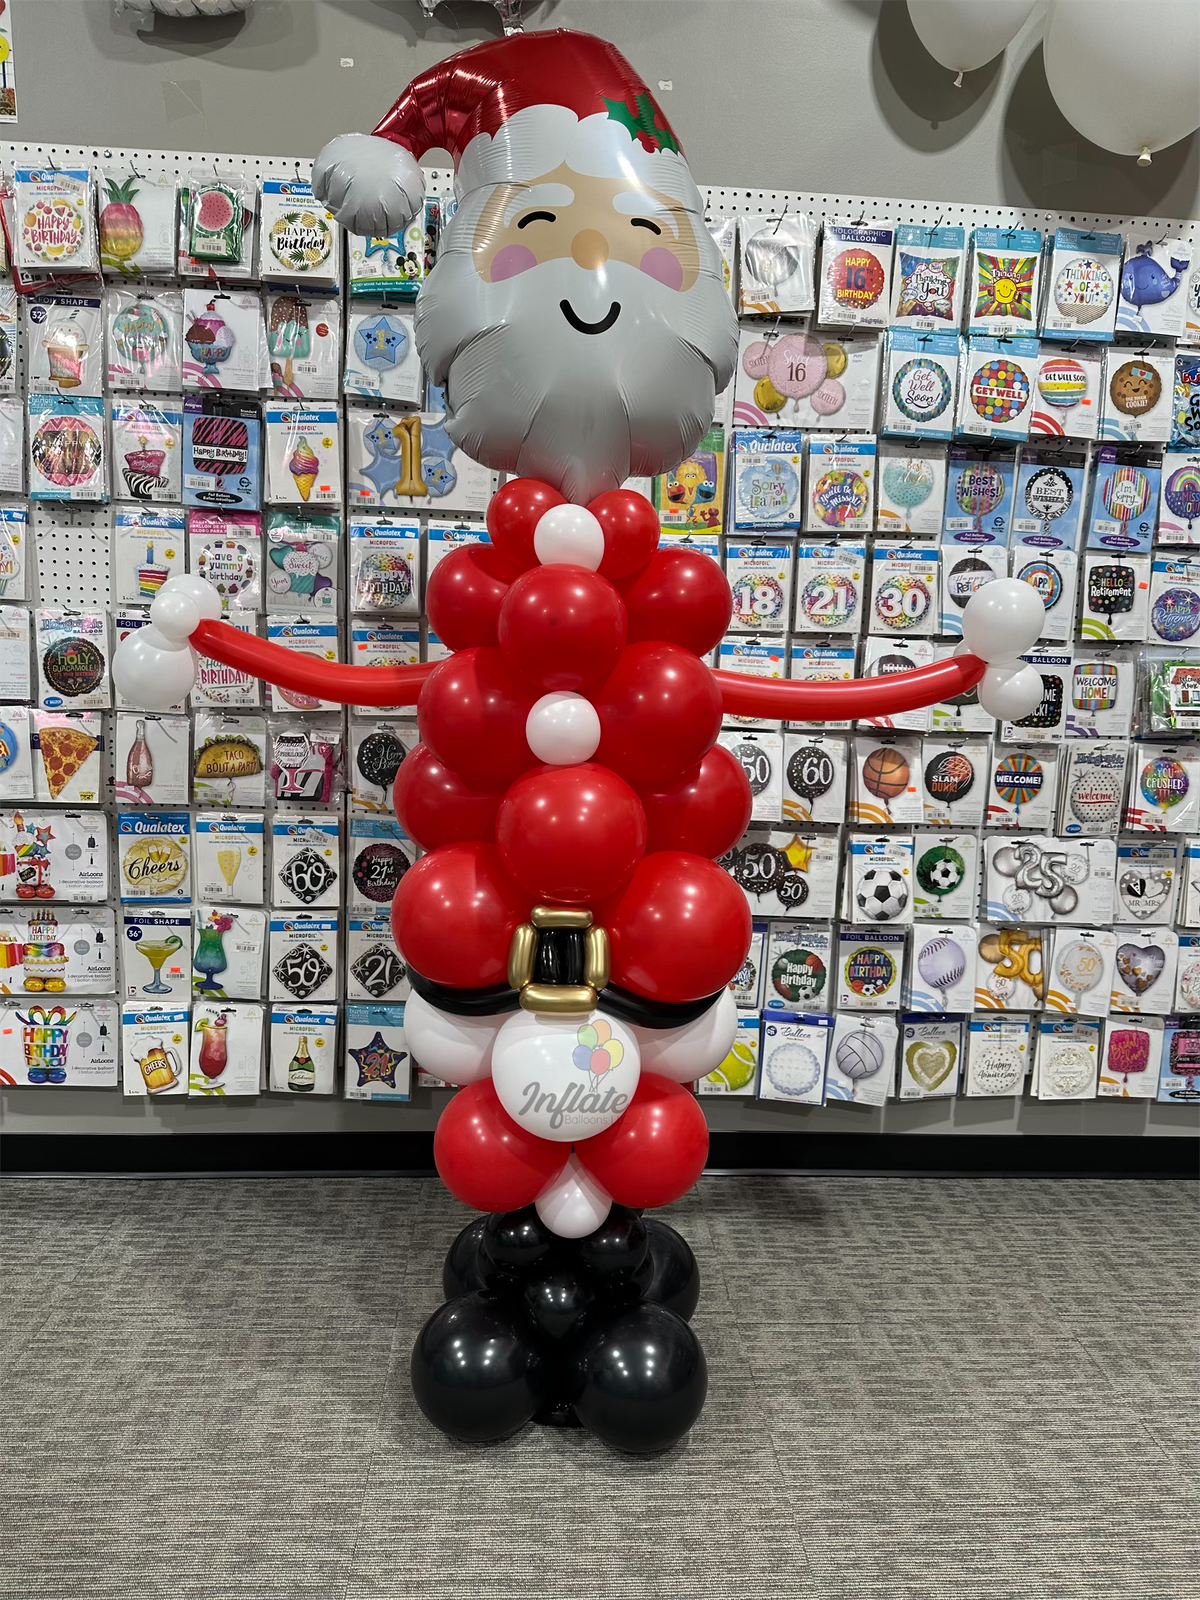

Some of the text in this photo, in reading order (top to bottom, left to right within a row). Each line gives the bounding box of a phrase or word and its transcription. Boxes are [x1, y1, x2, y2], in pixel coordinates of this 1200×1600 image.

[37, 215, 71, 230] HAPPY
[31, 229, 78, 245] BIRTHDAY
[284, 228, 318, 236] HAPPY
[832, 228, 886, 237] HOLOGRAPHIC
[841, 234, 877, 242] BALLOON
[1058, 231, 1077, 239] burton
[277, 238, 325, 250] Birthday
[846, 257, 871, 267] HAPPY
[915, 274, 947, 287] Thinking
[991, 269, 1022, 281] Thinking
[1066, 268, 1107, 281] THINKING
[1080, 282, 1090, 292] OF
[837, 289, 874, 300] BIRTHDAY
[1074, 293, 1095, 304] YOU!
[60, 298, 88, 306] SHAPE
[749, 355, 770, 368] SIXTEEN
[787, 363, 806, 382] 16
[913, 370, 931, 381] Get
[908, 380, 935, 392] Well
[817, 390, 838, 406] SIXTEEN
[975, 386, 1023, 399] GET WELL
[1126, 400, 1148, 408] COOKIE!
[292, 413, 320, 421] Qualatex
[750, 440, 798, 452] Qualatex
[752, 479, 785, 496] Sorry
[1036, 487, 1064, 495] BEST
[210, 562, 243, 572] yummy
[289, 558, 312, 570] Sweet
[210, 572, 243, 582] birthday
[1101, 578, 1123, 587] HELLO
[1091, 586, 1131, 597] Retirement
[740, 585, 776, 615] 18
[810, 585, 847, 615] 21
[879, 588, 926, 618] 30
[1166, 605, 1192, 614] HAPPY
[1157, 609, 1200, 626] Retirement
[743, 648, 768, 656] Qualatex
[201, 669, 249, 684] BIRTHDAY!
[1076, 676, 1117, 686] WELCOME
[1081, 687, 1110, 698] HOME!
[225, 751, 244, 760] TACO
[231, 764, 236, 772] A
[238, 762, 257, 772] PARTY
[802, 757, 833, 785] 60
[1158, 767, 1174, 778] YOU
[996, 775, 1041, 784] WELCOME!
[1146, 778, 1184, 789] CRUSHED
[932, 783, 957, 792] DUNK!
[1078, 787, 1116, 800] welcome!
[135, 821, 185, 833] Qualatex
[220, 824, 246, 832] Qualatex
[372, 856, 393, 865] Happy
[742, 852, 776, 878] 50
[128, 856, 182, 879] Cheers
[1014, 843, 1067, 898] 25
[291, 861, 327, 892] 60
[367, 877, 398, 887] Birthday!
[780, 881, 802, 900] 50
[32, 926, 55, 934] HAPPY
[294, 922, 320, 930] Qualatex
[857, 954, 885, 964] HAPPY
[1077, 958, 1096, 972] 50
[287, 956, 322, 987] 50
[365, 955, 394, 986] 21
[786, 962, 813, 975] Happy
[850, 966, 891, 978] BIRTHDAY
[780, 974, 817, 988] Birthday
[349, 1008, 368, 1016] burton
[295, 1016, 320, 1024] Qualatex
[23, 1028, 69, 1043] HAPPY
[24, 1044, 69, 1056] BIRTHDAY
[1112, 1033, 1138, 1060] Bridal
[25, 1056, 67, 1067] TO YOU
[366, 1052, 389, 1076] 21
[985, 1059, 1012, 1072] Happy
[144, 1060, 167, 1076] CHEERS
